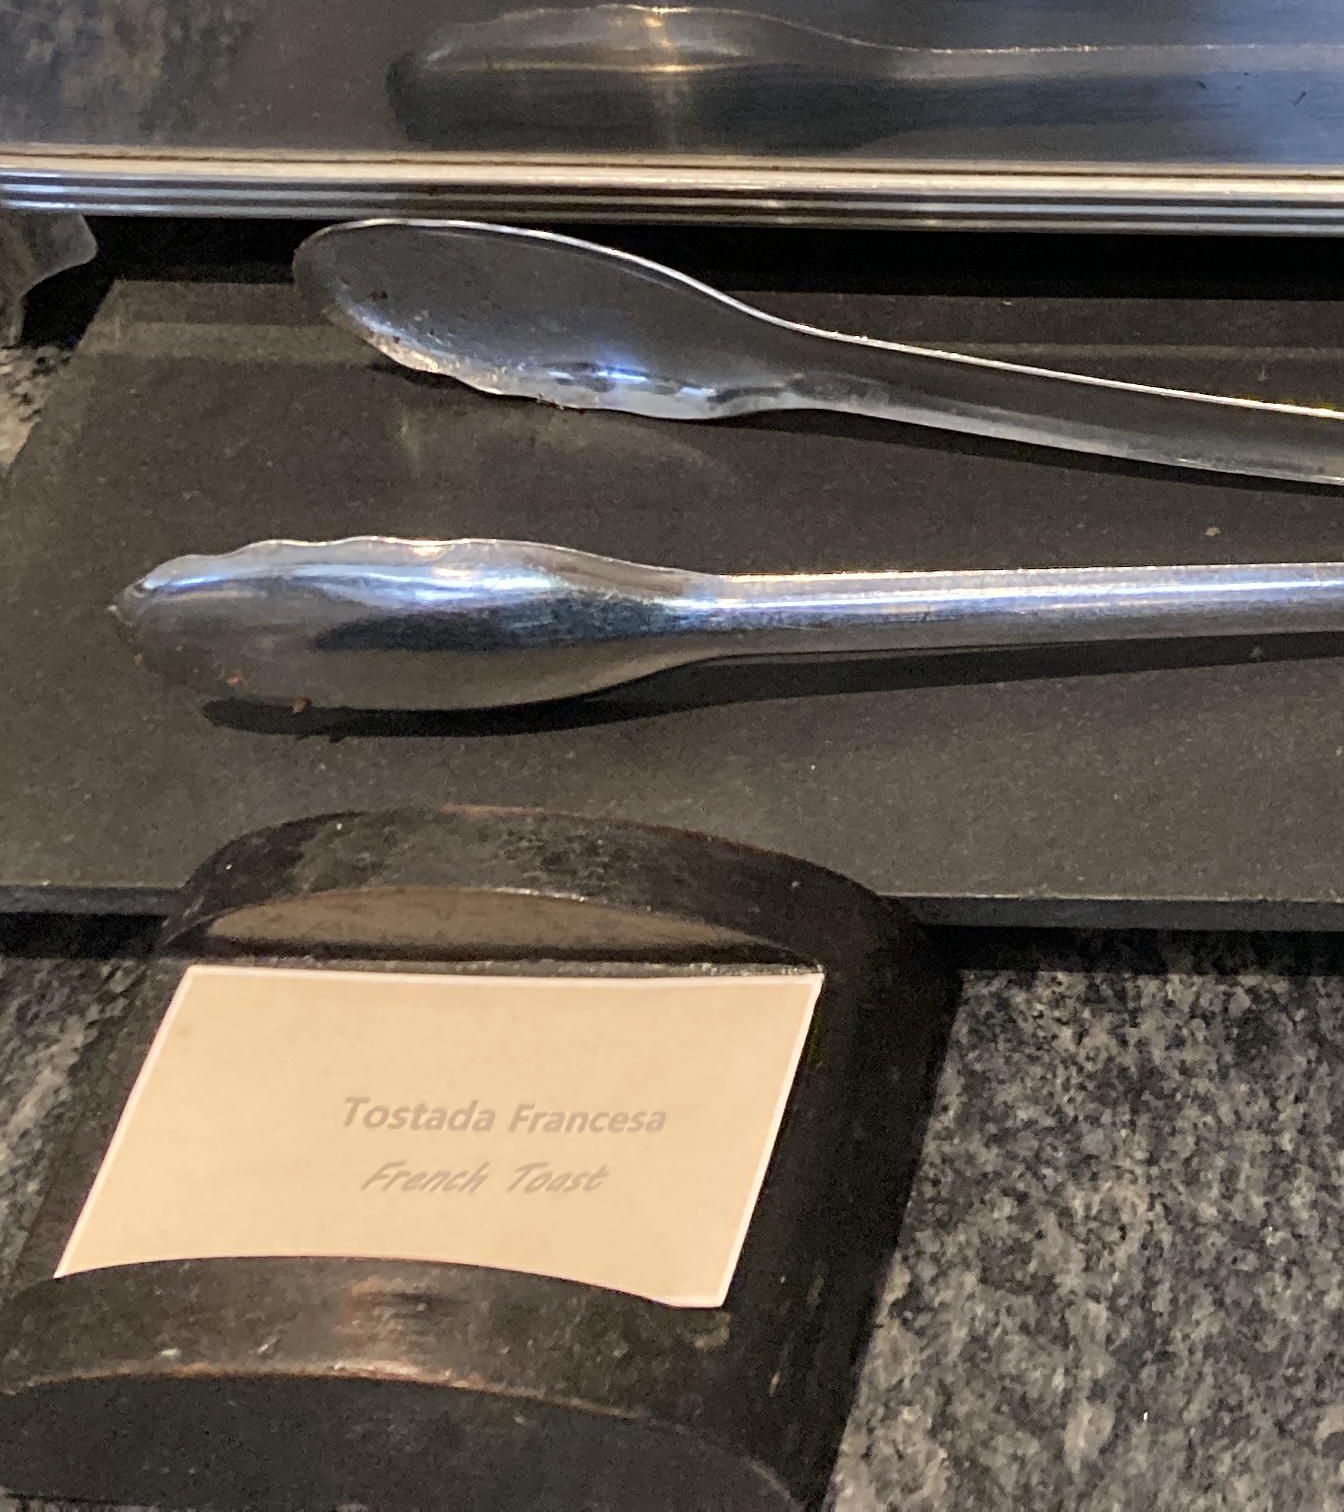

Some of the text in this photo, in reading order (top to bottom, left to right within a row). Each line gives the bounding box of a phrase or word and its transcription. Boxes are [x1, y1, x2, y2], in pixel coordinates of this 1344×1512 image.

[343, 1096, 667, 1133] Tostada Francesa
[360, 1160, 609, 1194] French Toast
